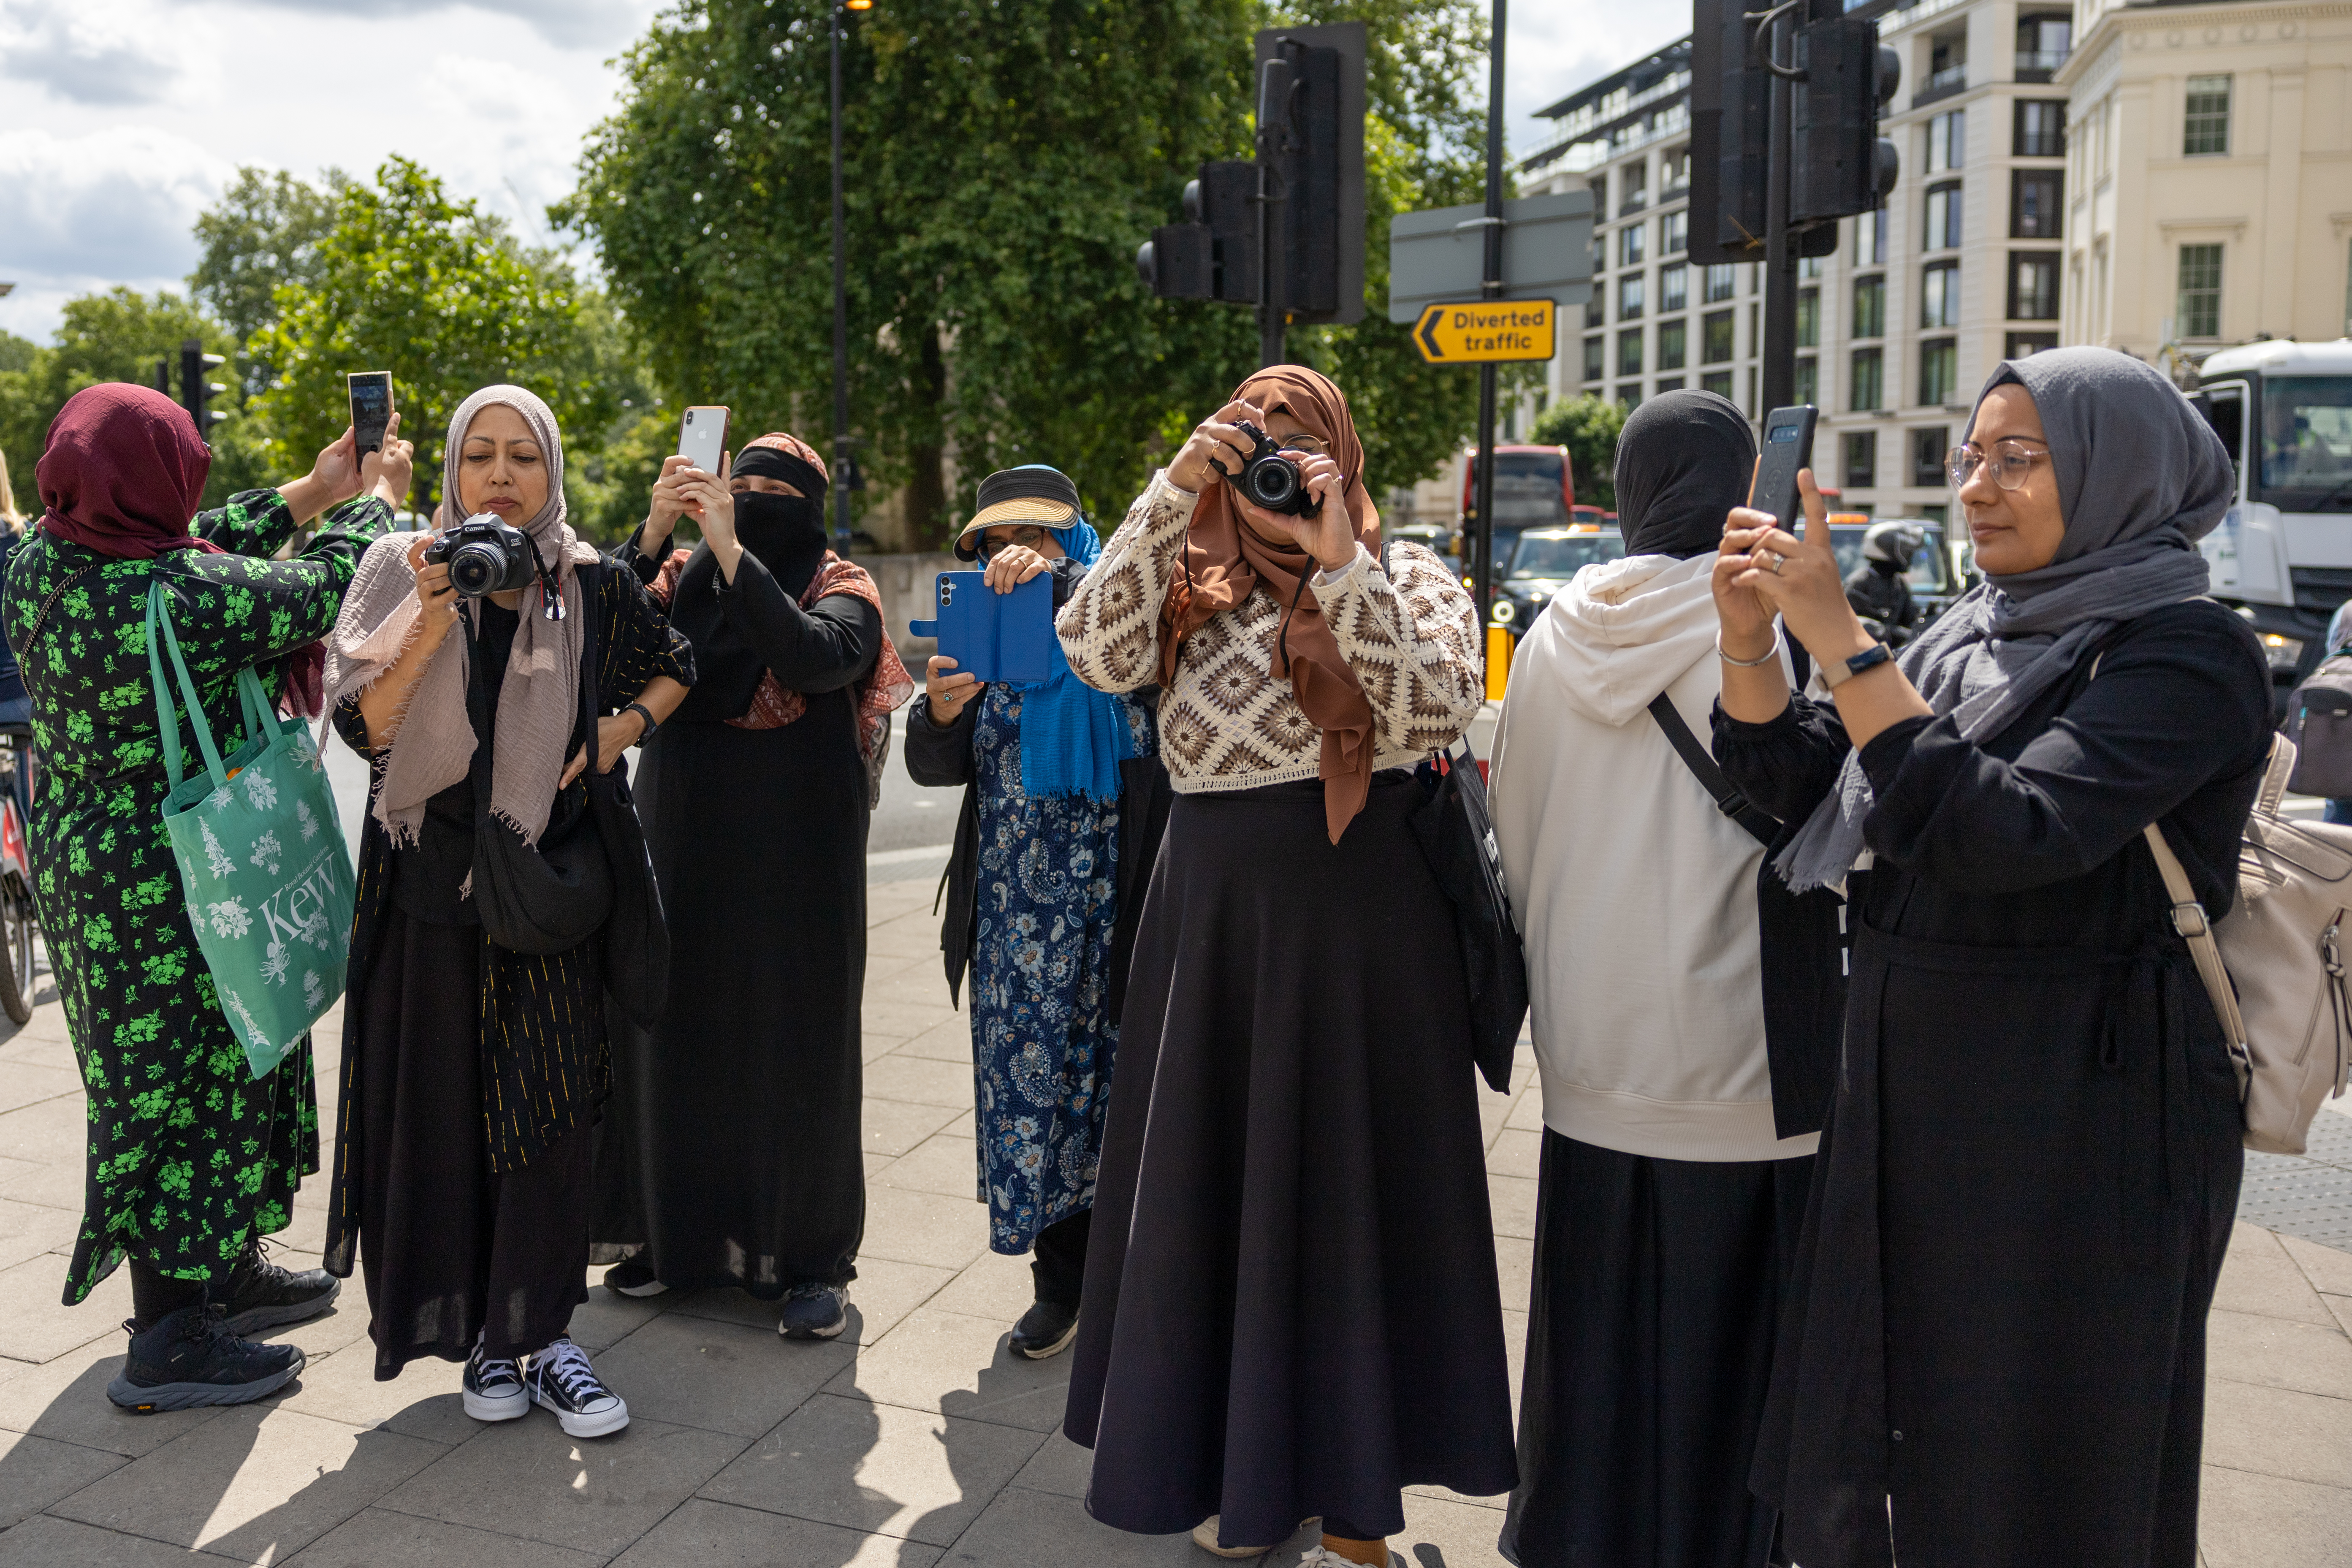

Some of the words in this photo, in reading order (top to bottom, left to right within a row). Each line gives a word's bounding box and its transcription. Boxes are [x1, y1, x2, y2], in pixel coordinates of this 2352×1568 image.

[1454, 308, 1545, 329] Diverted
[1465, 332, 1532, 351] traffic
[284, 876, 298, 891] Royal
[297, 861, 313, 880] Botanic
[312, 845, 329, 863] Gardens
[258, 852, 336, 947] Kew
